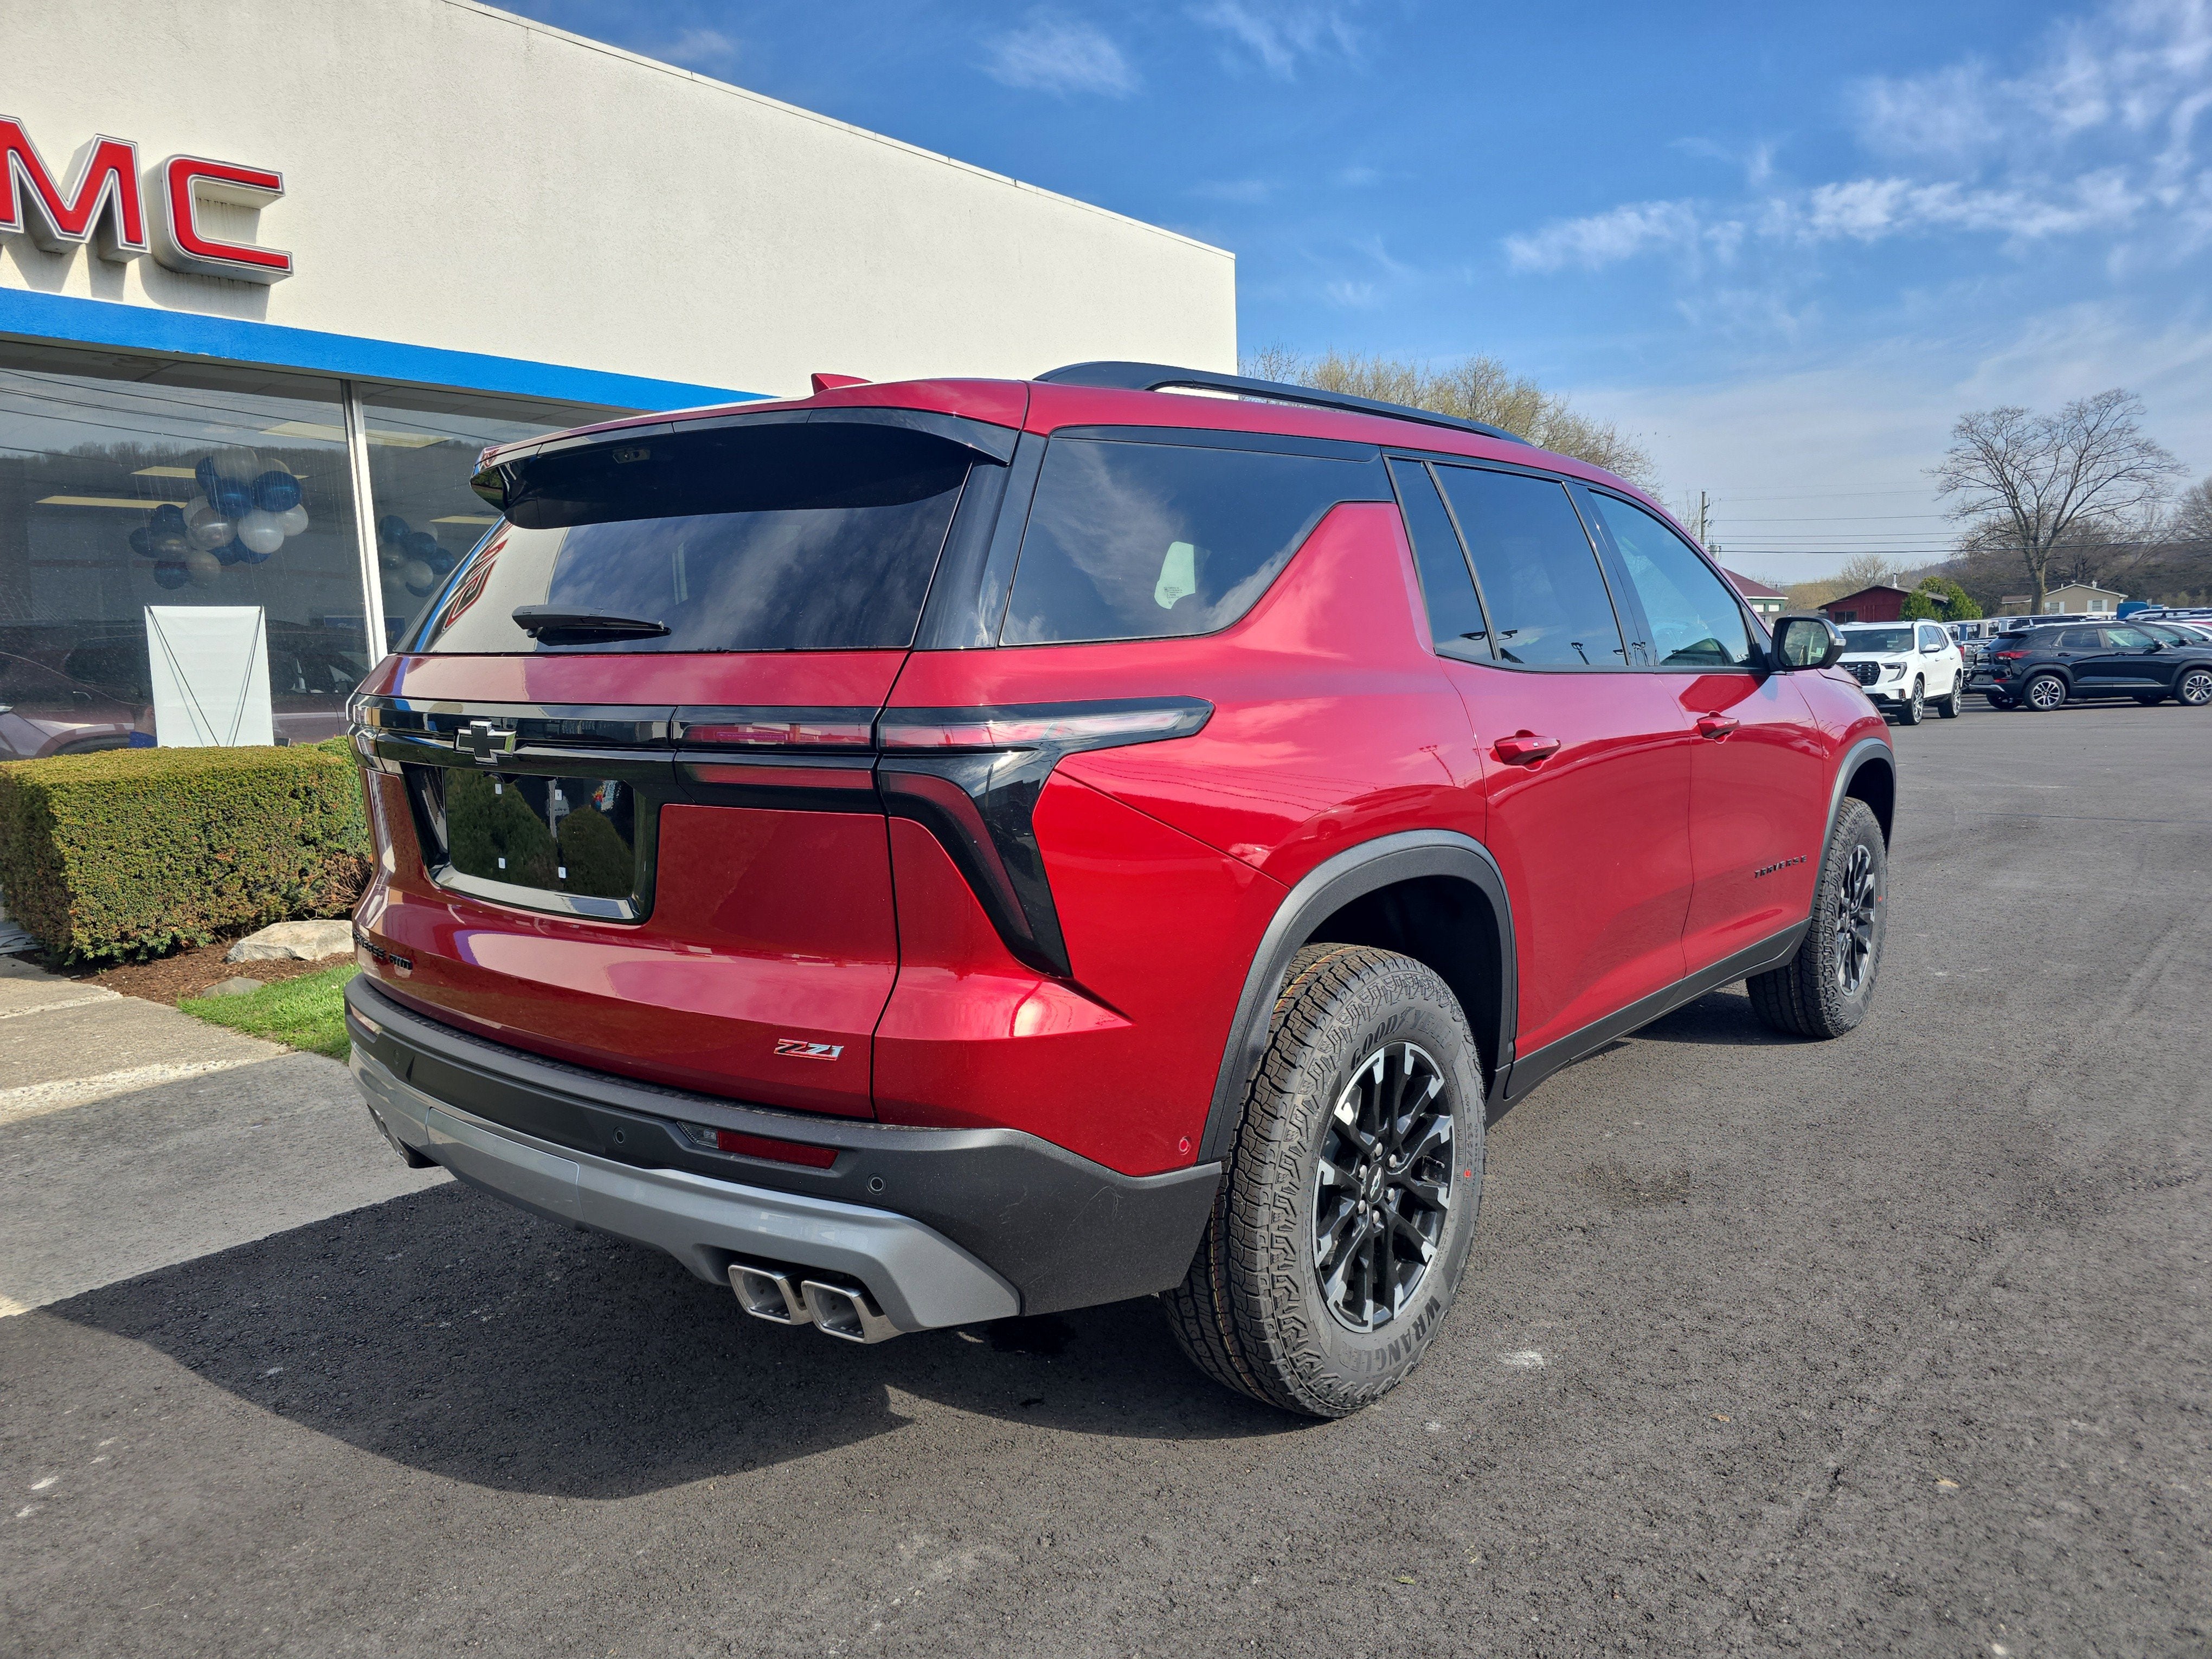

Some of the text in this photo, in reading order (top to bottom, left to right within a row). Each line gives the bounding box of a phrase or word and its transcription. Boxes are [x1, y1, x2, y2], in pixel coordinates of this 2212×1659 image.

[1753, 854, 1808, 879] TRAVERSE
[774, 1038, 845, 1061] Z71
[1351, 1006, 1455, 1071] GOODYEAR
[1339, 1295, 1441, 1374] WRANGLER
